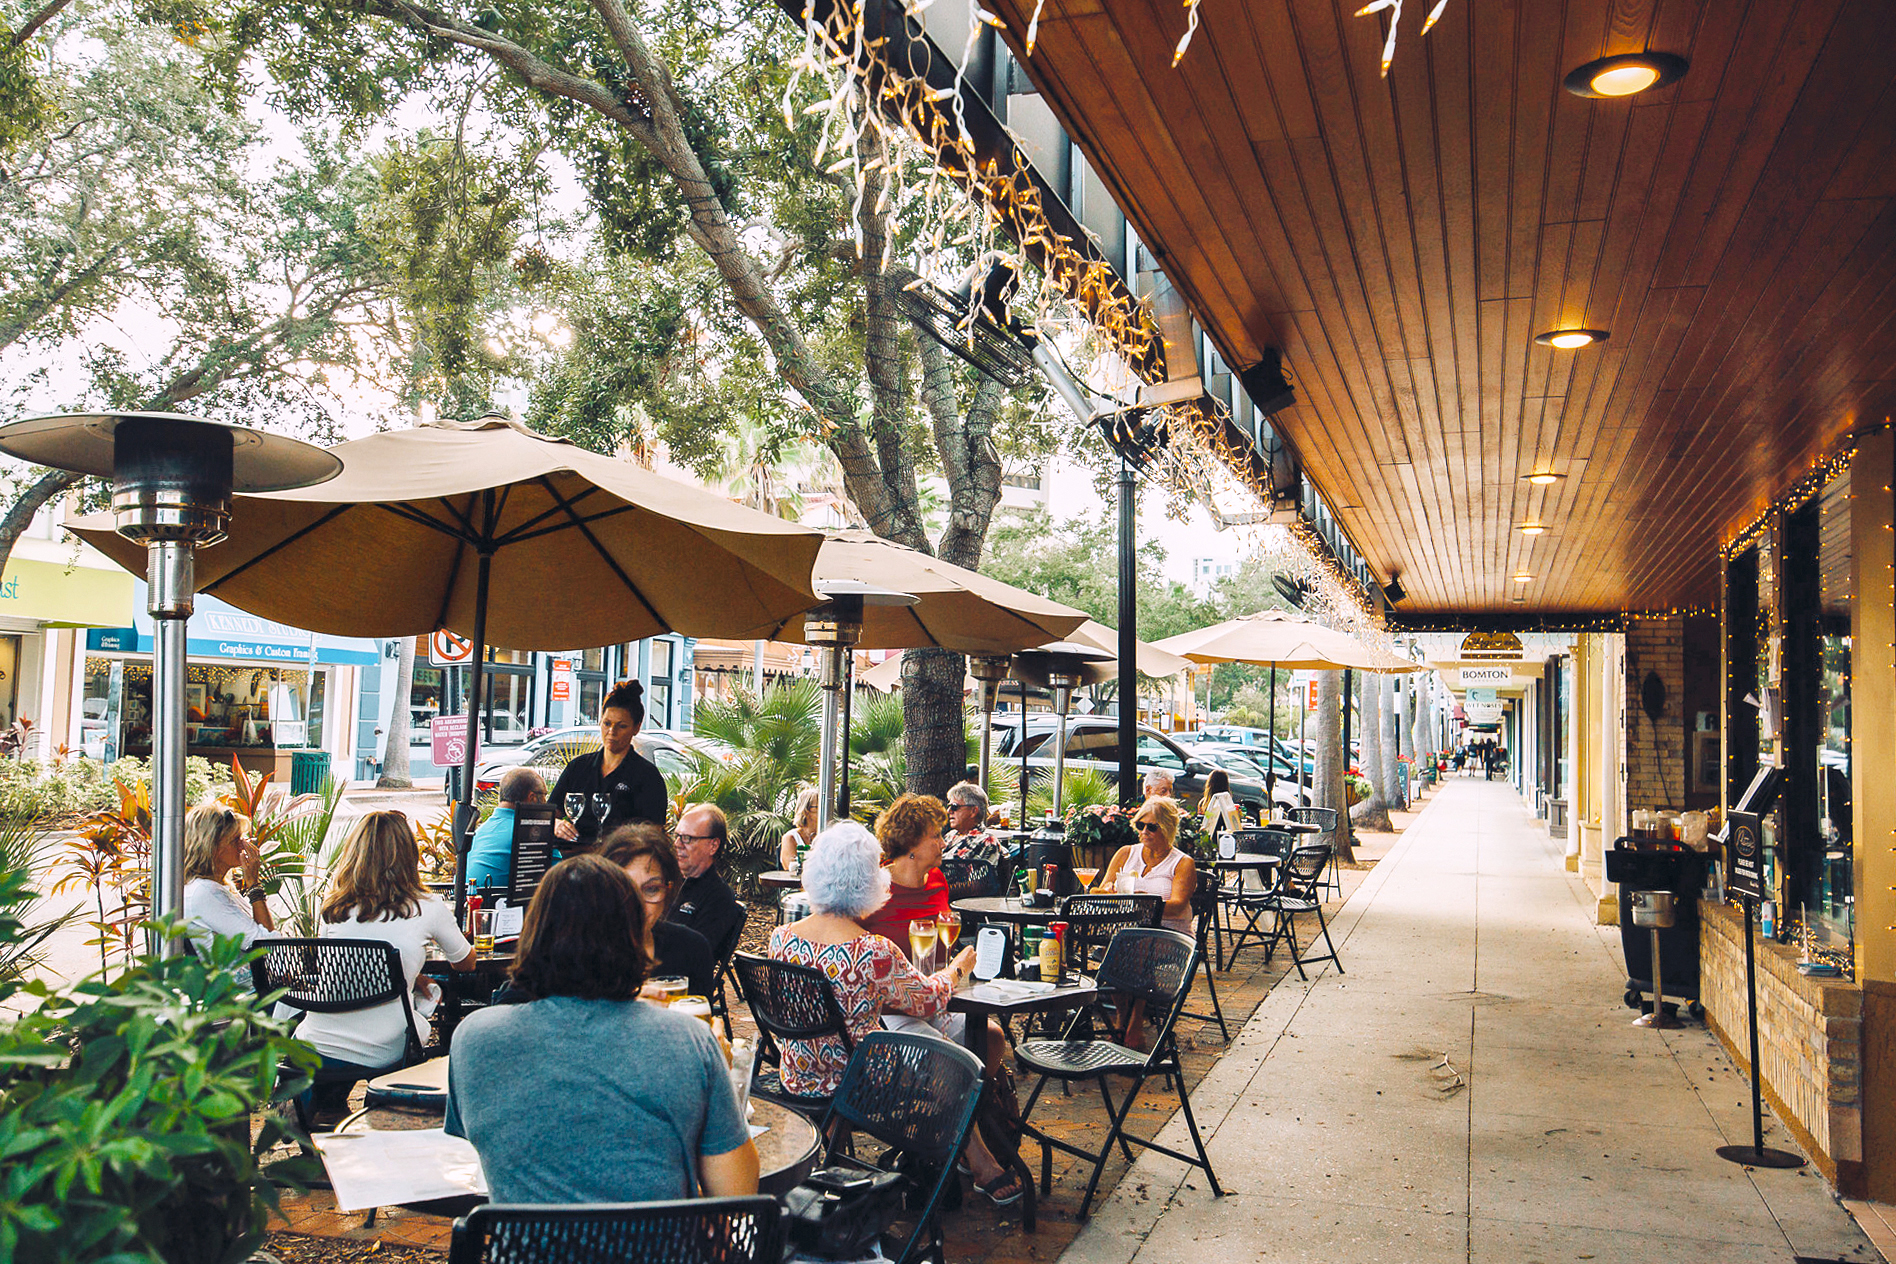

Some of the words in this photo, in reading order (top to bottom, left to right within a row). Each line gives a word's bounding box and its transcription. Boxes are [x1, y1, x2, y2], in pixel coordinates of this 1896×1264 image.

[208, 614, 264, 633] KENNEDY
[268, 622, 316, 637] STUDIO
[219, 642, 254, 657] Graphics
[255, 645, 262, 656] &
[264, 646, 291, 658] Custom
[293, 648, 319, 662] Framig
[1462, 670, 1508, 679] BOMTON
